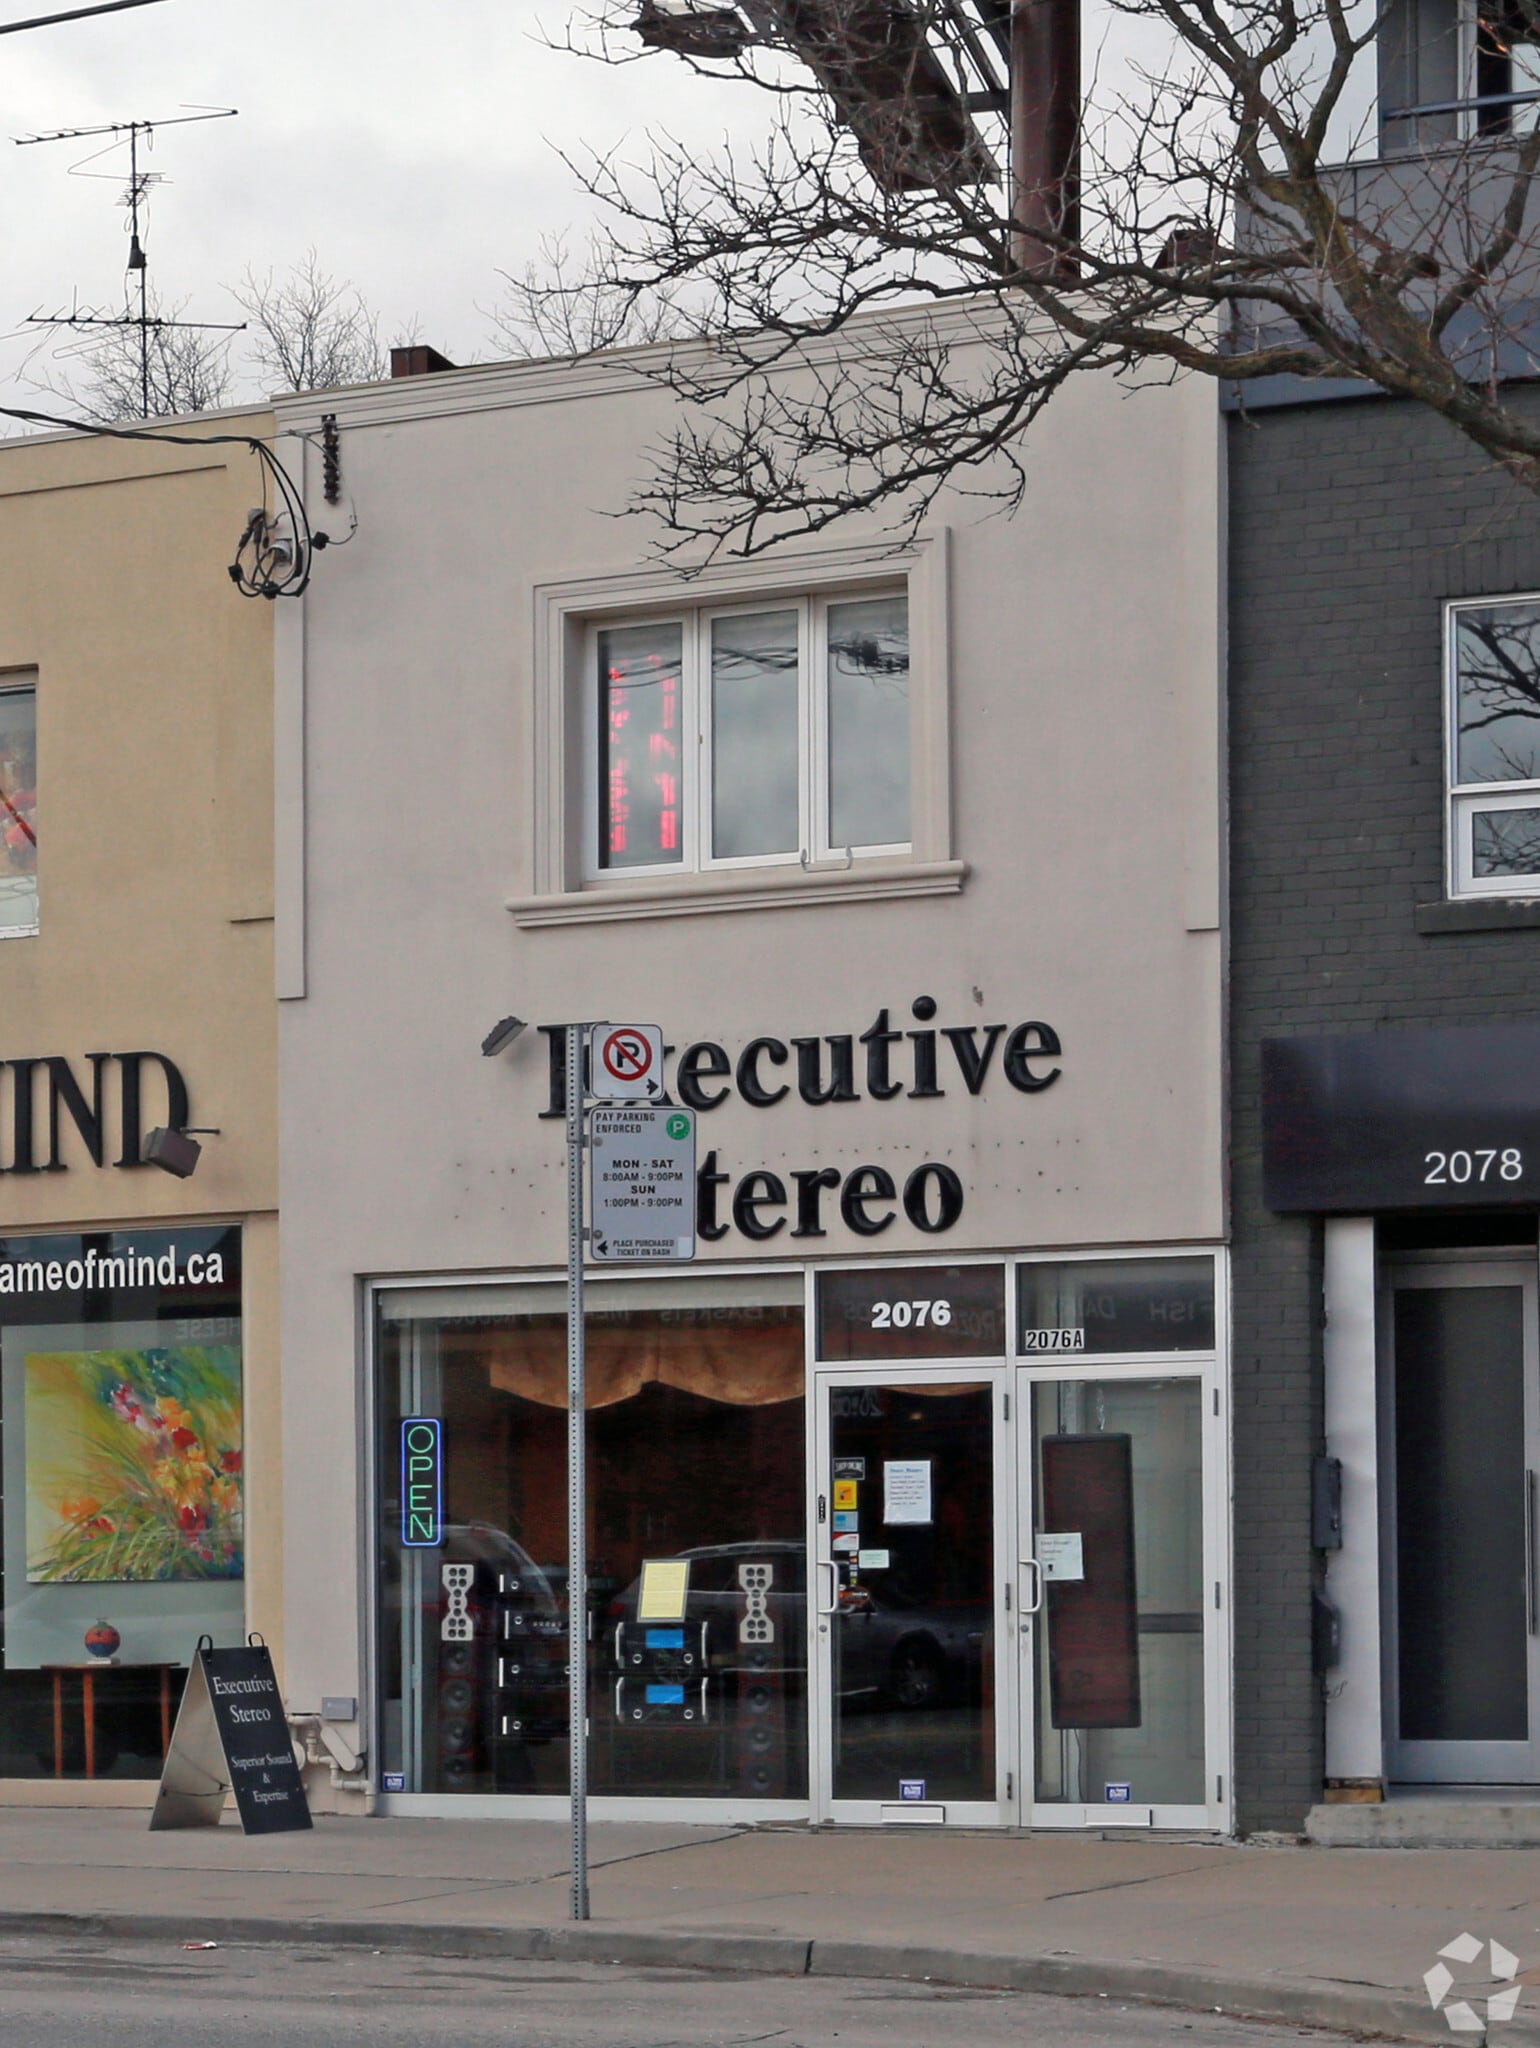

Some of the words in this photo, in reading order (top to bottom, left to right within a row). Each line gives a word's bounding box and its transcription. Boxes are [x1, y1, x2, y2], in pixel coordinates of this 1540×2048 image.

[595, 1112, 614, 1122] PAY
[616, 1112, 656, 1122] PARKING
[595, 1124, 642, 1134] ENFORCED
[612, 1159, 640, 1168] MON
[651, 1159, 674, 1168] SAT
[1423, 1147, 1524, 1184] 2078
[602, 1172, 639, 1182] 8:00AM
[647, 1172, 683, 1182] 9:00PM
[631, 1185, 656, 1194] SUN
[604, 1198, 639, 1208] 1:00PM
[647, 1198, 683, 1208] 9:00PM
[612, 1239, 633, 1247] PLACE
[635, 1239, 674, 1247] PURCHASED
[617, 1248, 639, 1256] TICKET
[641, 1248, 650, 1256] ON
[0, 1245, 224, 1293] ameofmind.ca
[871, 1300, 951, 1328] 2076
[1027, 1330, 1084, 1348] 2076A
[408, 1425, 434, 1539] OPEN
[212, 1674, 274, 1695] Executive
[229, 1704, 271, 1723] Stereo
[231, 1754, 265, 1771] Superior
[266, 1751, 293, 1766] Sound
[262, 1772, 271, 1784] &
